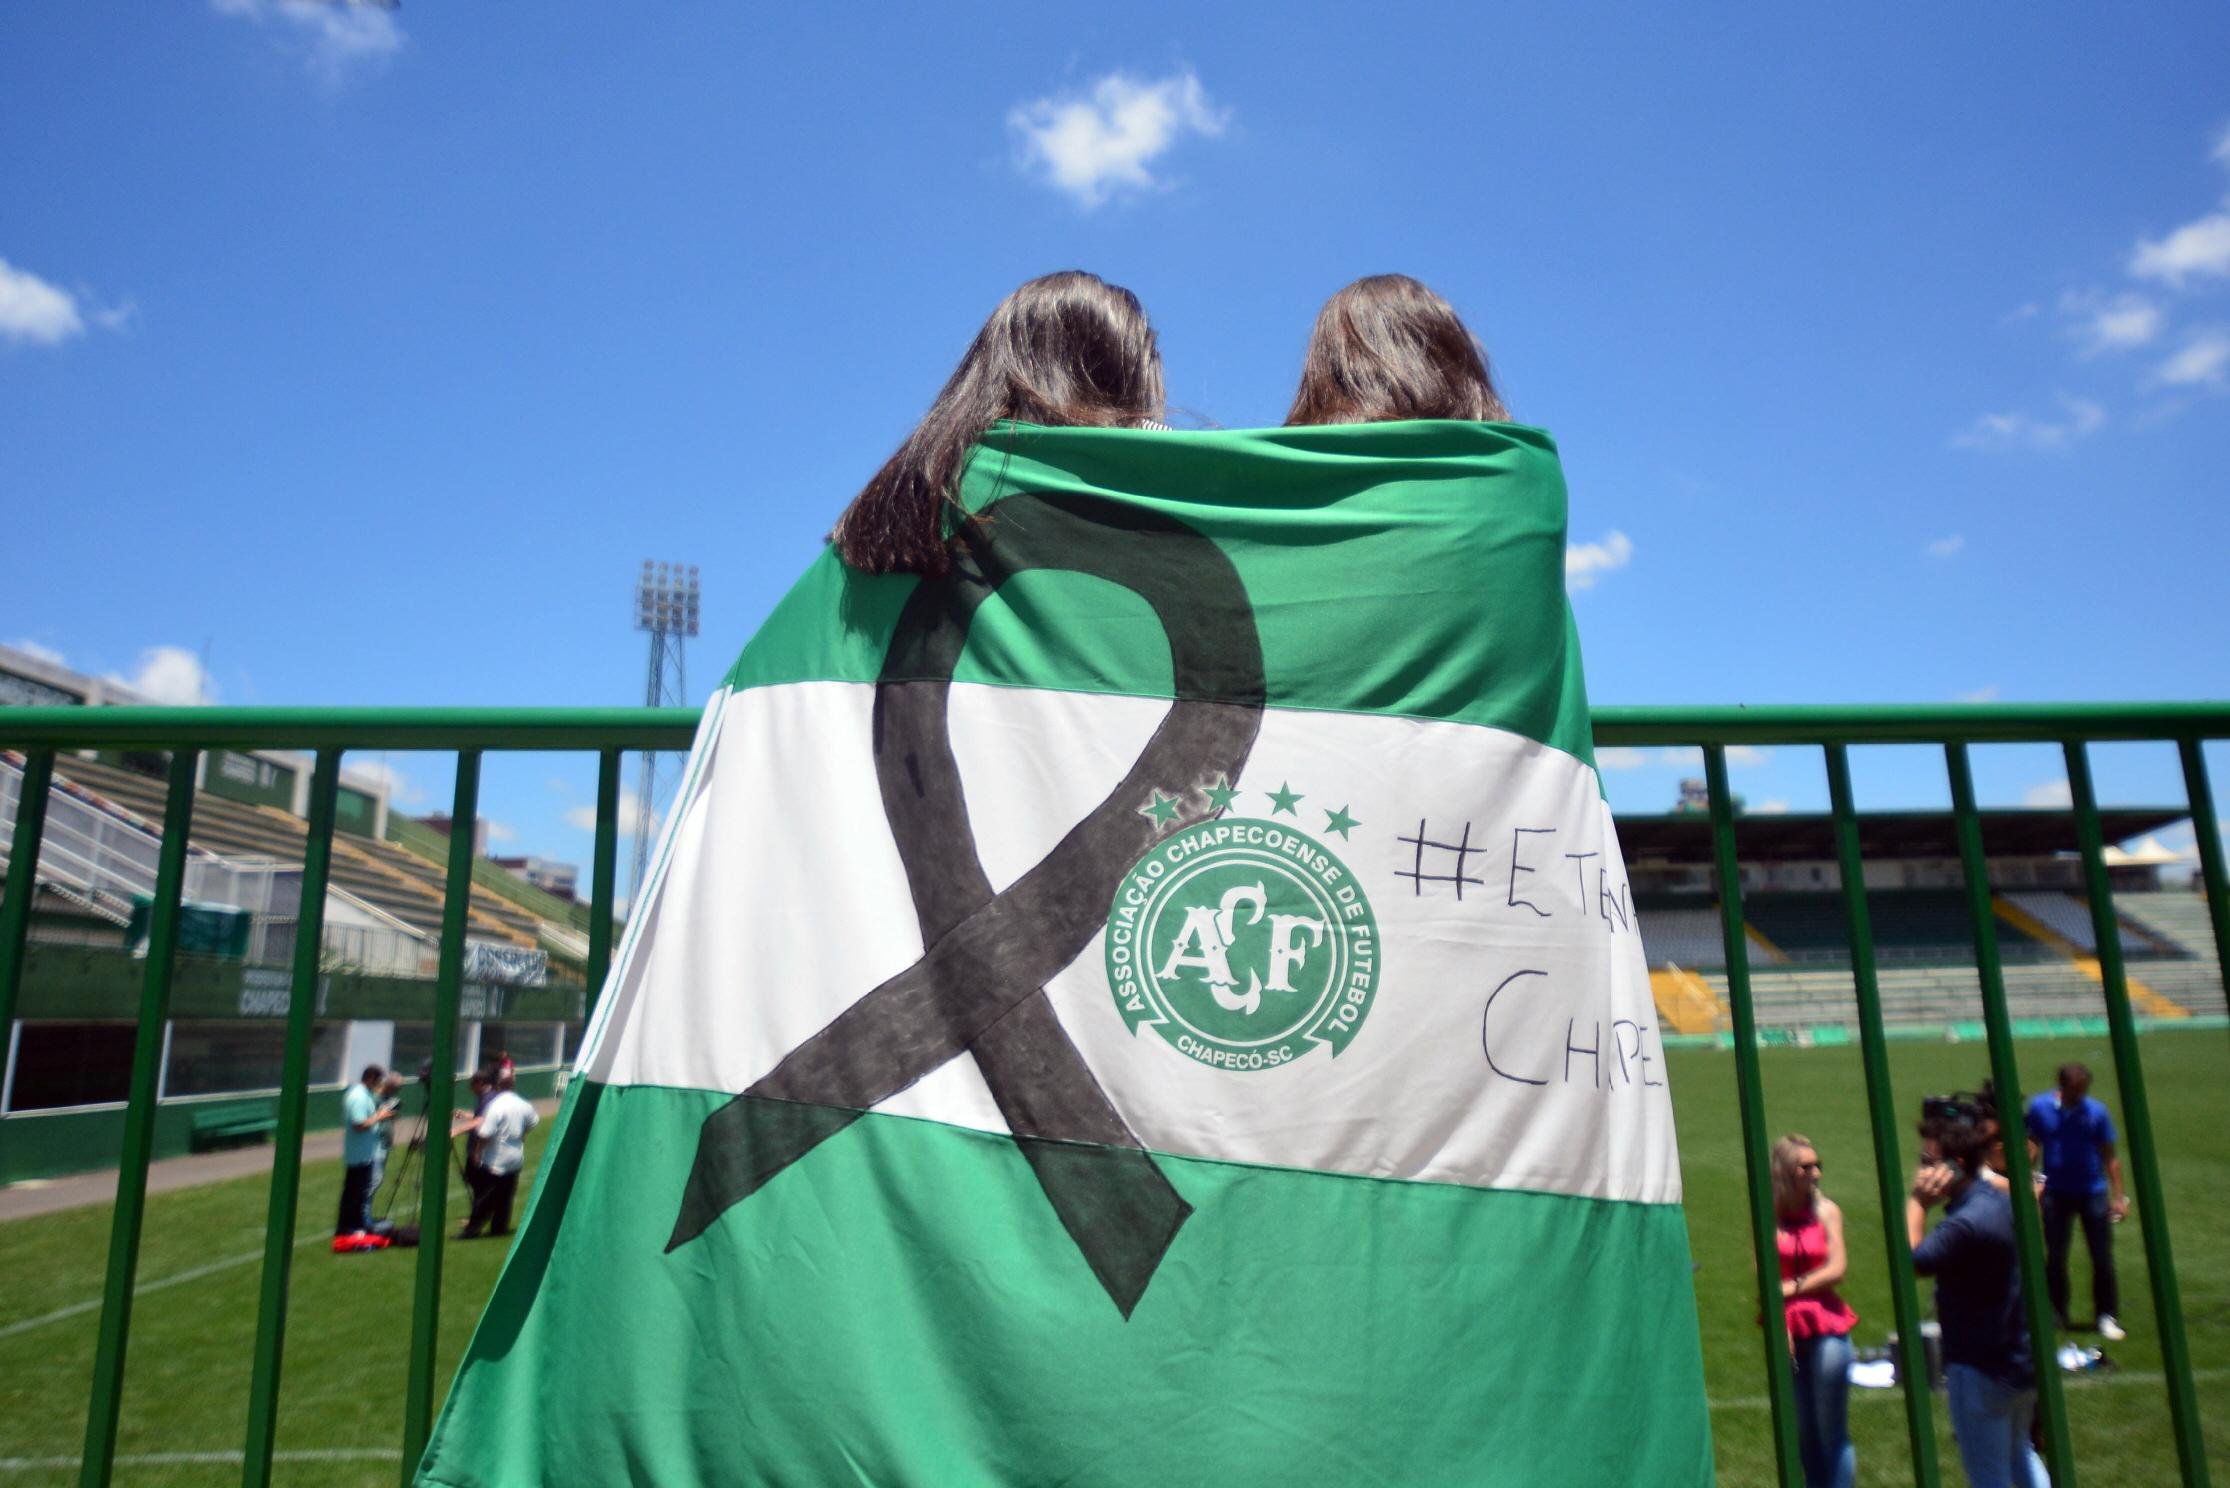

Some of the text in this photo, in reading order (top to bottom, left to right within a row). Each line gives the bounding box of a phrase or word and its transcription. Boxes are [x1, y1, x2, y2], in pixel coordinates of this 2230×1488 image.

[1112, 825, 1373, 1033] ASSOCIAÇÃO CHAPECOENSE DE FUTEBOL
[1176, 1034, 1293, 1069] CHAPECÓ-SC
[1482, 968, 1663, 1092] CHPE
